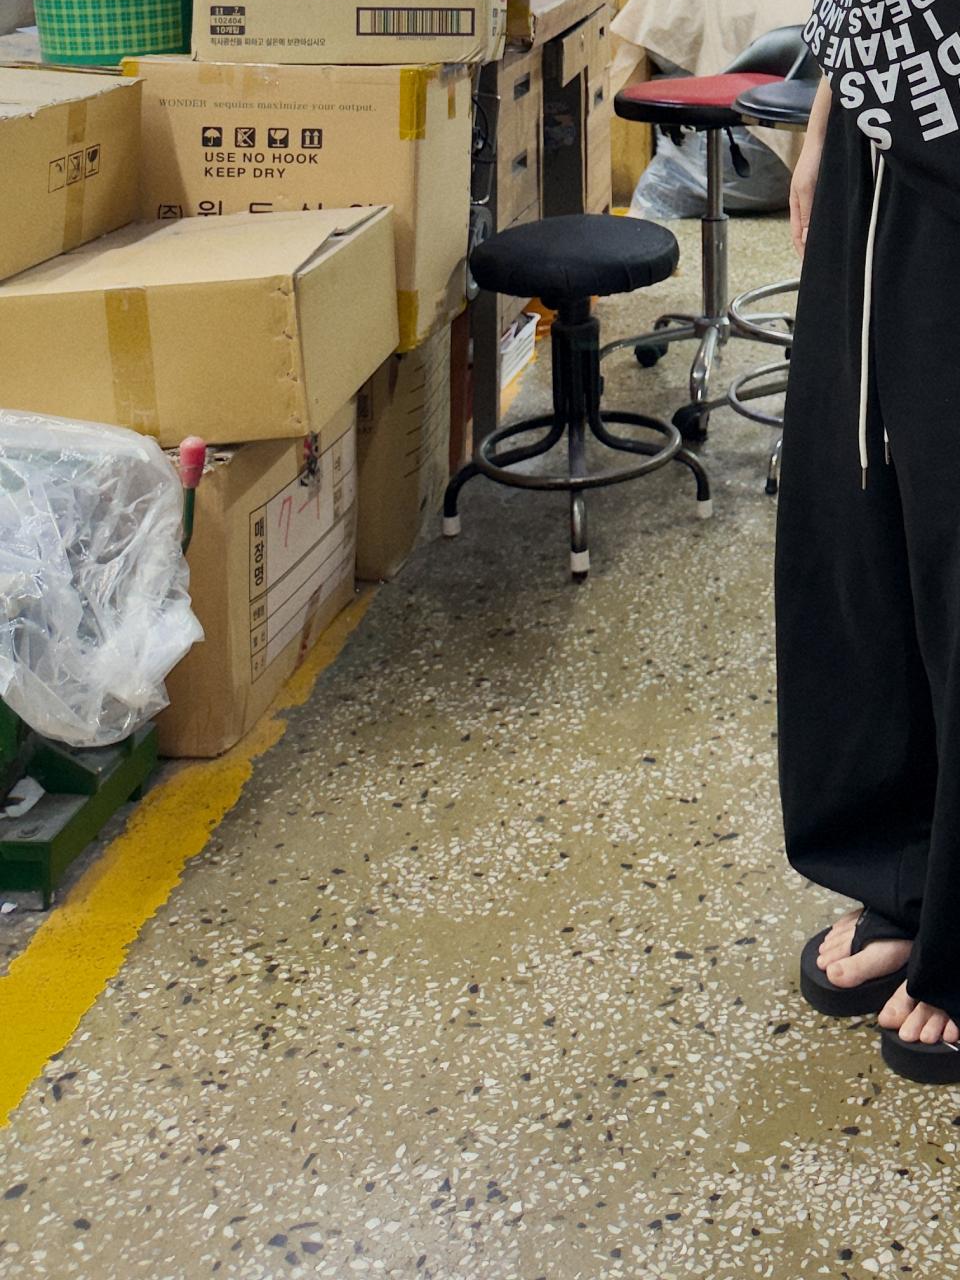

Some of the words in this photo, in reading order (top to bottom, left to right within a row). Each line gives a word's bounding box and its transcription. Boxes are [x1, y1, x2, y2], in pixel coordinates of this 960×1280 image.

[823, 23, 917, 68] HAVE
[204, 152, 236, 163] USE
[242, 153, 266, 164] NO
[272, 154, 319, 165] HOOK
[204, 166, 246, 178] KEEP
[253, 168, 286, 178] DRY
